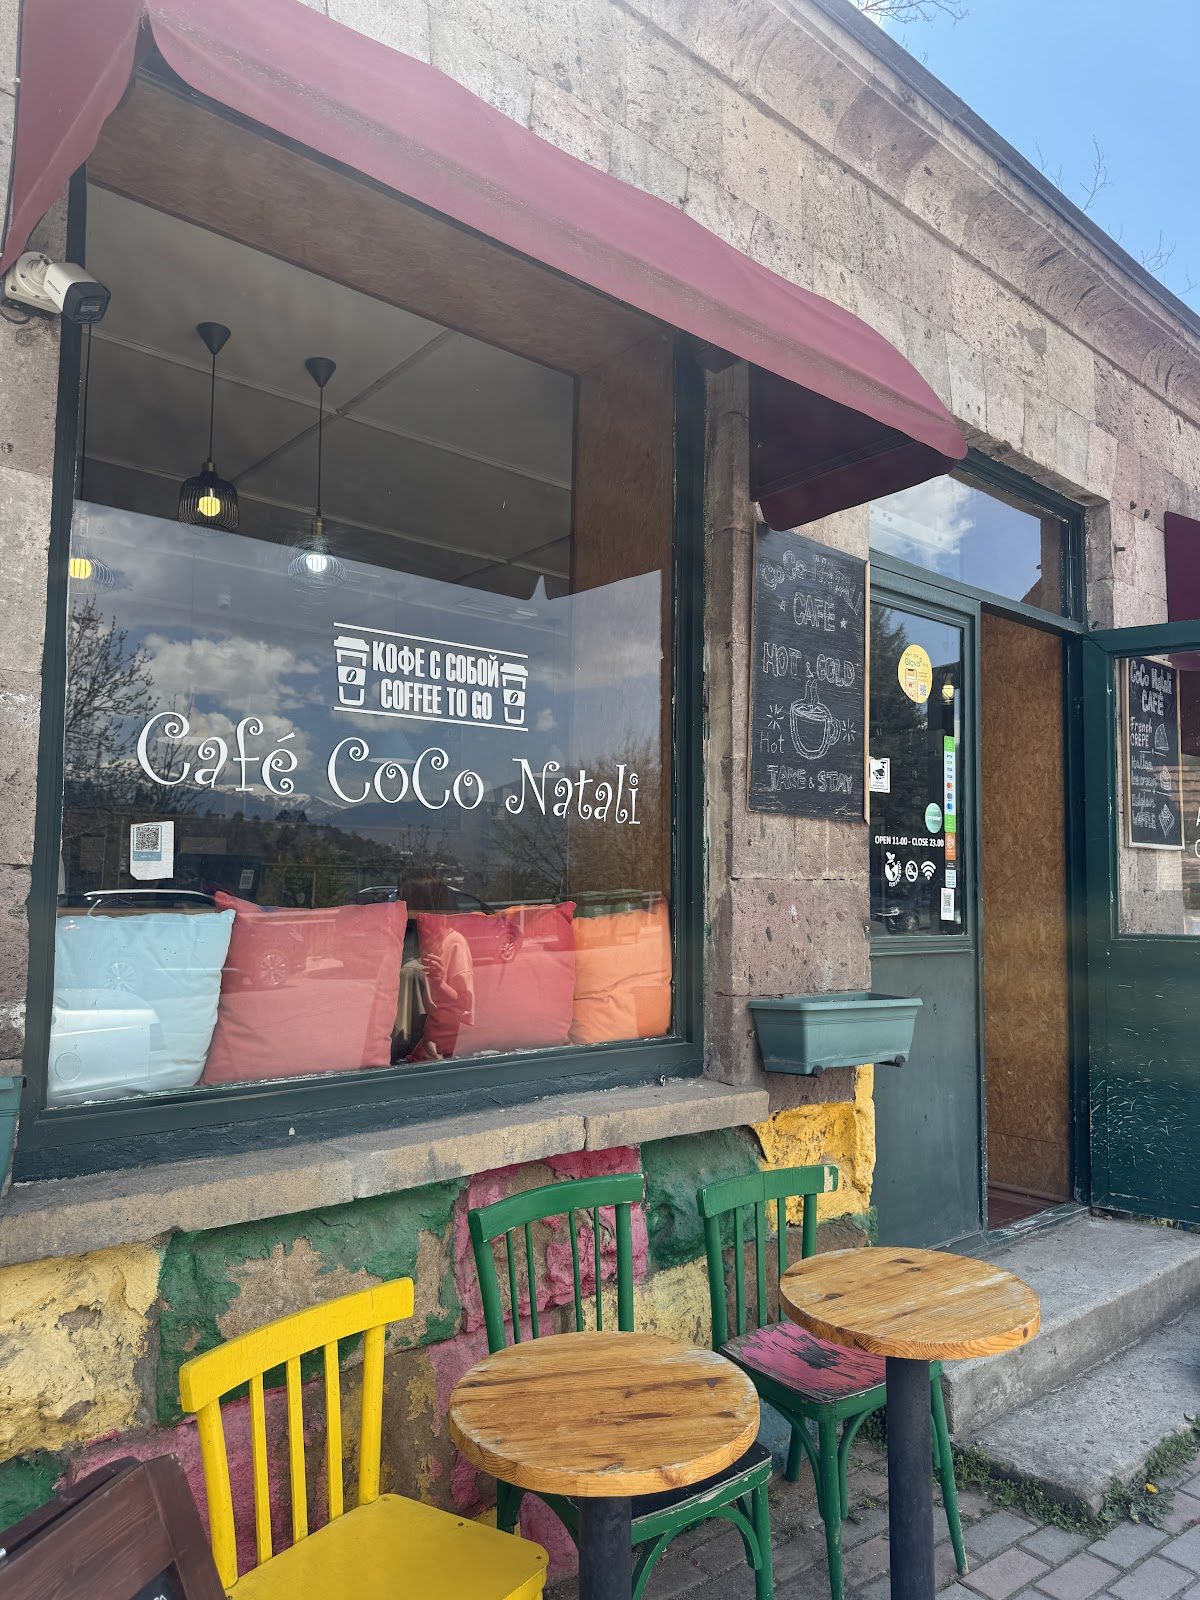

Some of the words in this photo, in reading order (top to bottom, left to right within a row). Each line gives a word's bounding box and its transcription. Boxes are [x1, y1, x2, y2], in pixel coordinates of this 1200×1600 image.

[372, 640, 425, 678] КОФЕ
[429, 650, 441, 680] С
[445, 654, 499, 688] СОБОЙ
[763, 641, 803, 678] HOT
[805, 661, 815, 679] &
[816, 653, 856, 687] COLD
[1130, 660, 1150, 687] CoCo
[380, 678, 442, 715] COFFEE
[446, 687, 468, 718] TO
[471, 690, 493, 720] GO
[1130, 716, 1153, 734] French
[760, 732, 785, 754] Hot
[136, 711, 298, 796] Café
[327, 737, 484, 810] CoCo
[505, 758, 641, 825] Natali
[766, 764, 807, 792] TAKE
[817, 770, 853, 795] STAY
[874, 835, 891, 845] OPEN
[911, 837, 929, 847] CLOSE
[929, 838, 944, 848] 23.00
